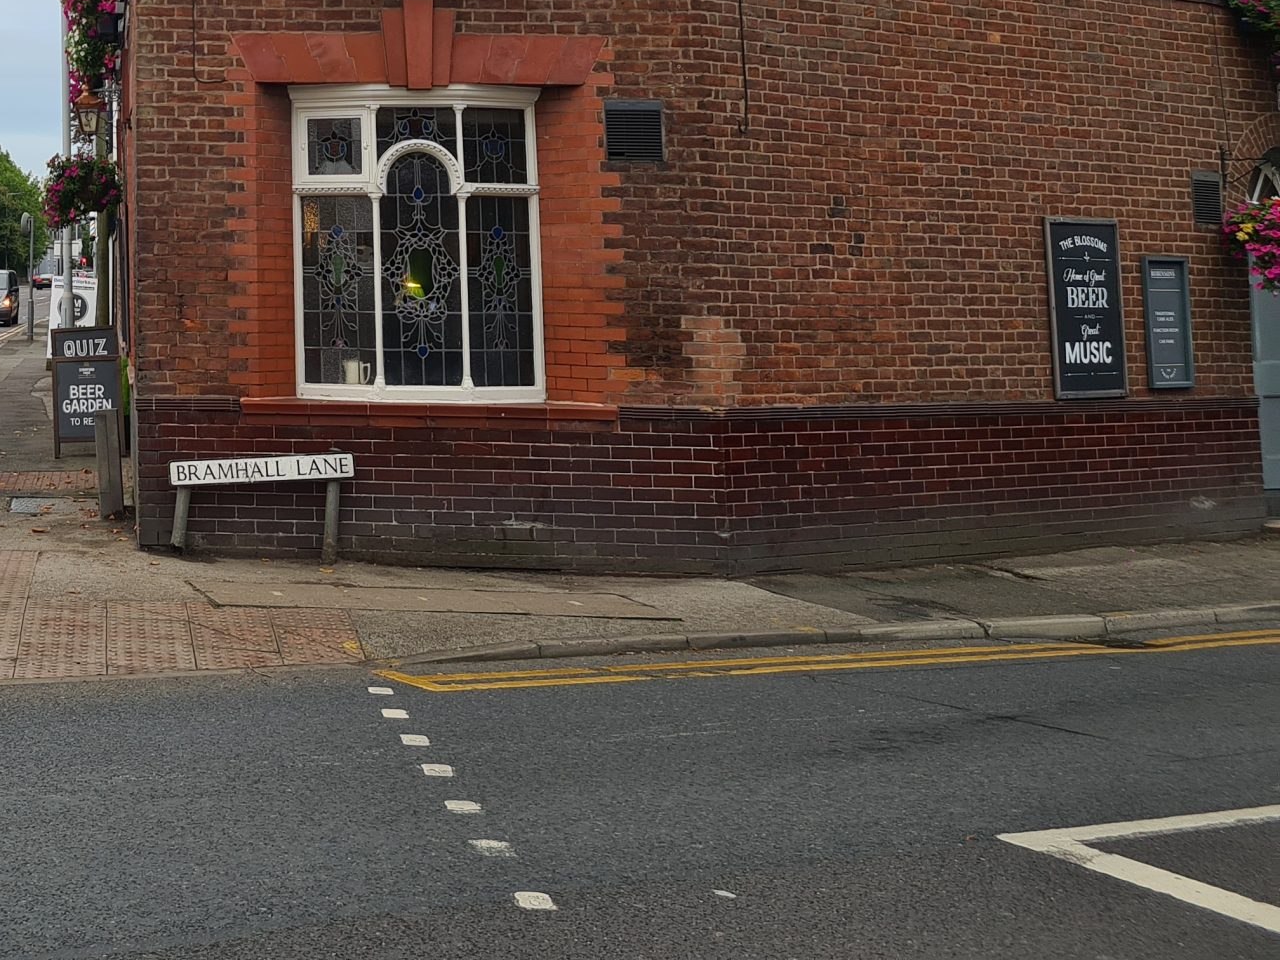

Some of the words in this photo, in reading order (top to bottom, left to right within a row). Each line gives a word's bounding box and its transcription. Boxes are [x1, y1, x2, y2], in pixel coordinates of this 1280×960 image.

[1059, 237, 1074, 250] THE
[1074, 235, 1107, 252] BLOSSOMS
[1063, 268, 1083, 282] Home
[1090, 269, 1106, 286] Great
[1066, 286, 1109, 308] BEER
[1081, 323, 1101, 340] Great
[63, 338, 108, 357] QUIZ
[1065, 341, 1112, 364] MUSIC
[69, 384, 104, 399] BEER
[62, 398, 112, 413] GARDEN
[70, 417, 81, 425] TO
[176, 460, 285, 482] BRAMHALL
[296, 457, 350, 477] LANE
